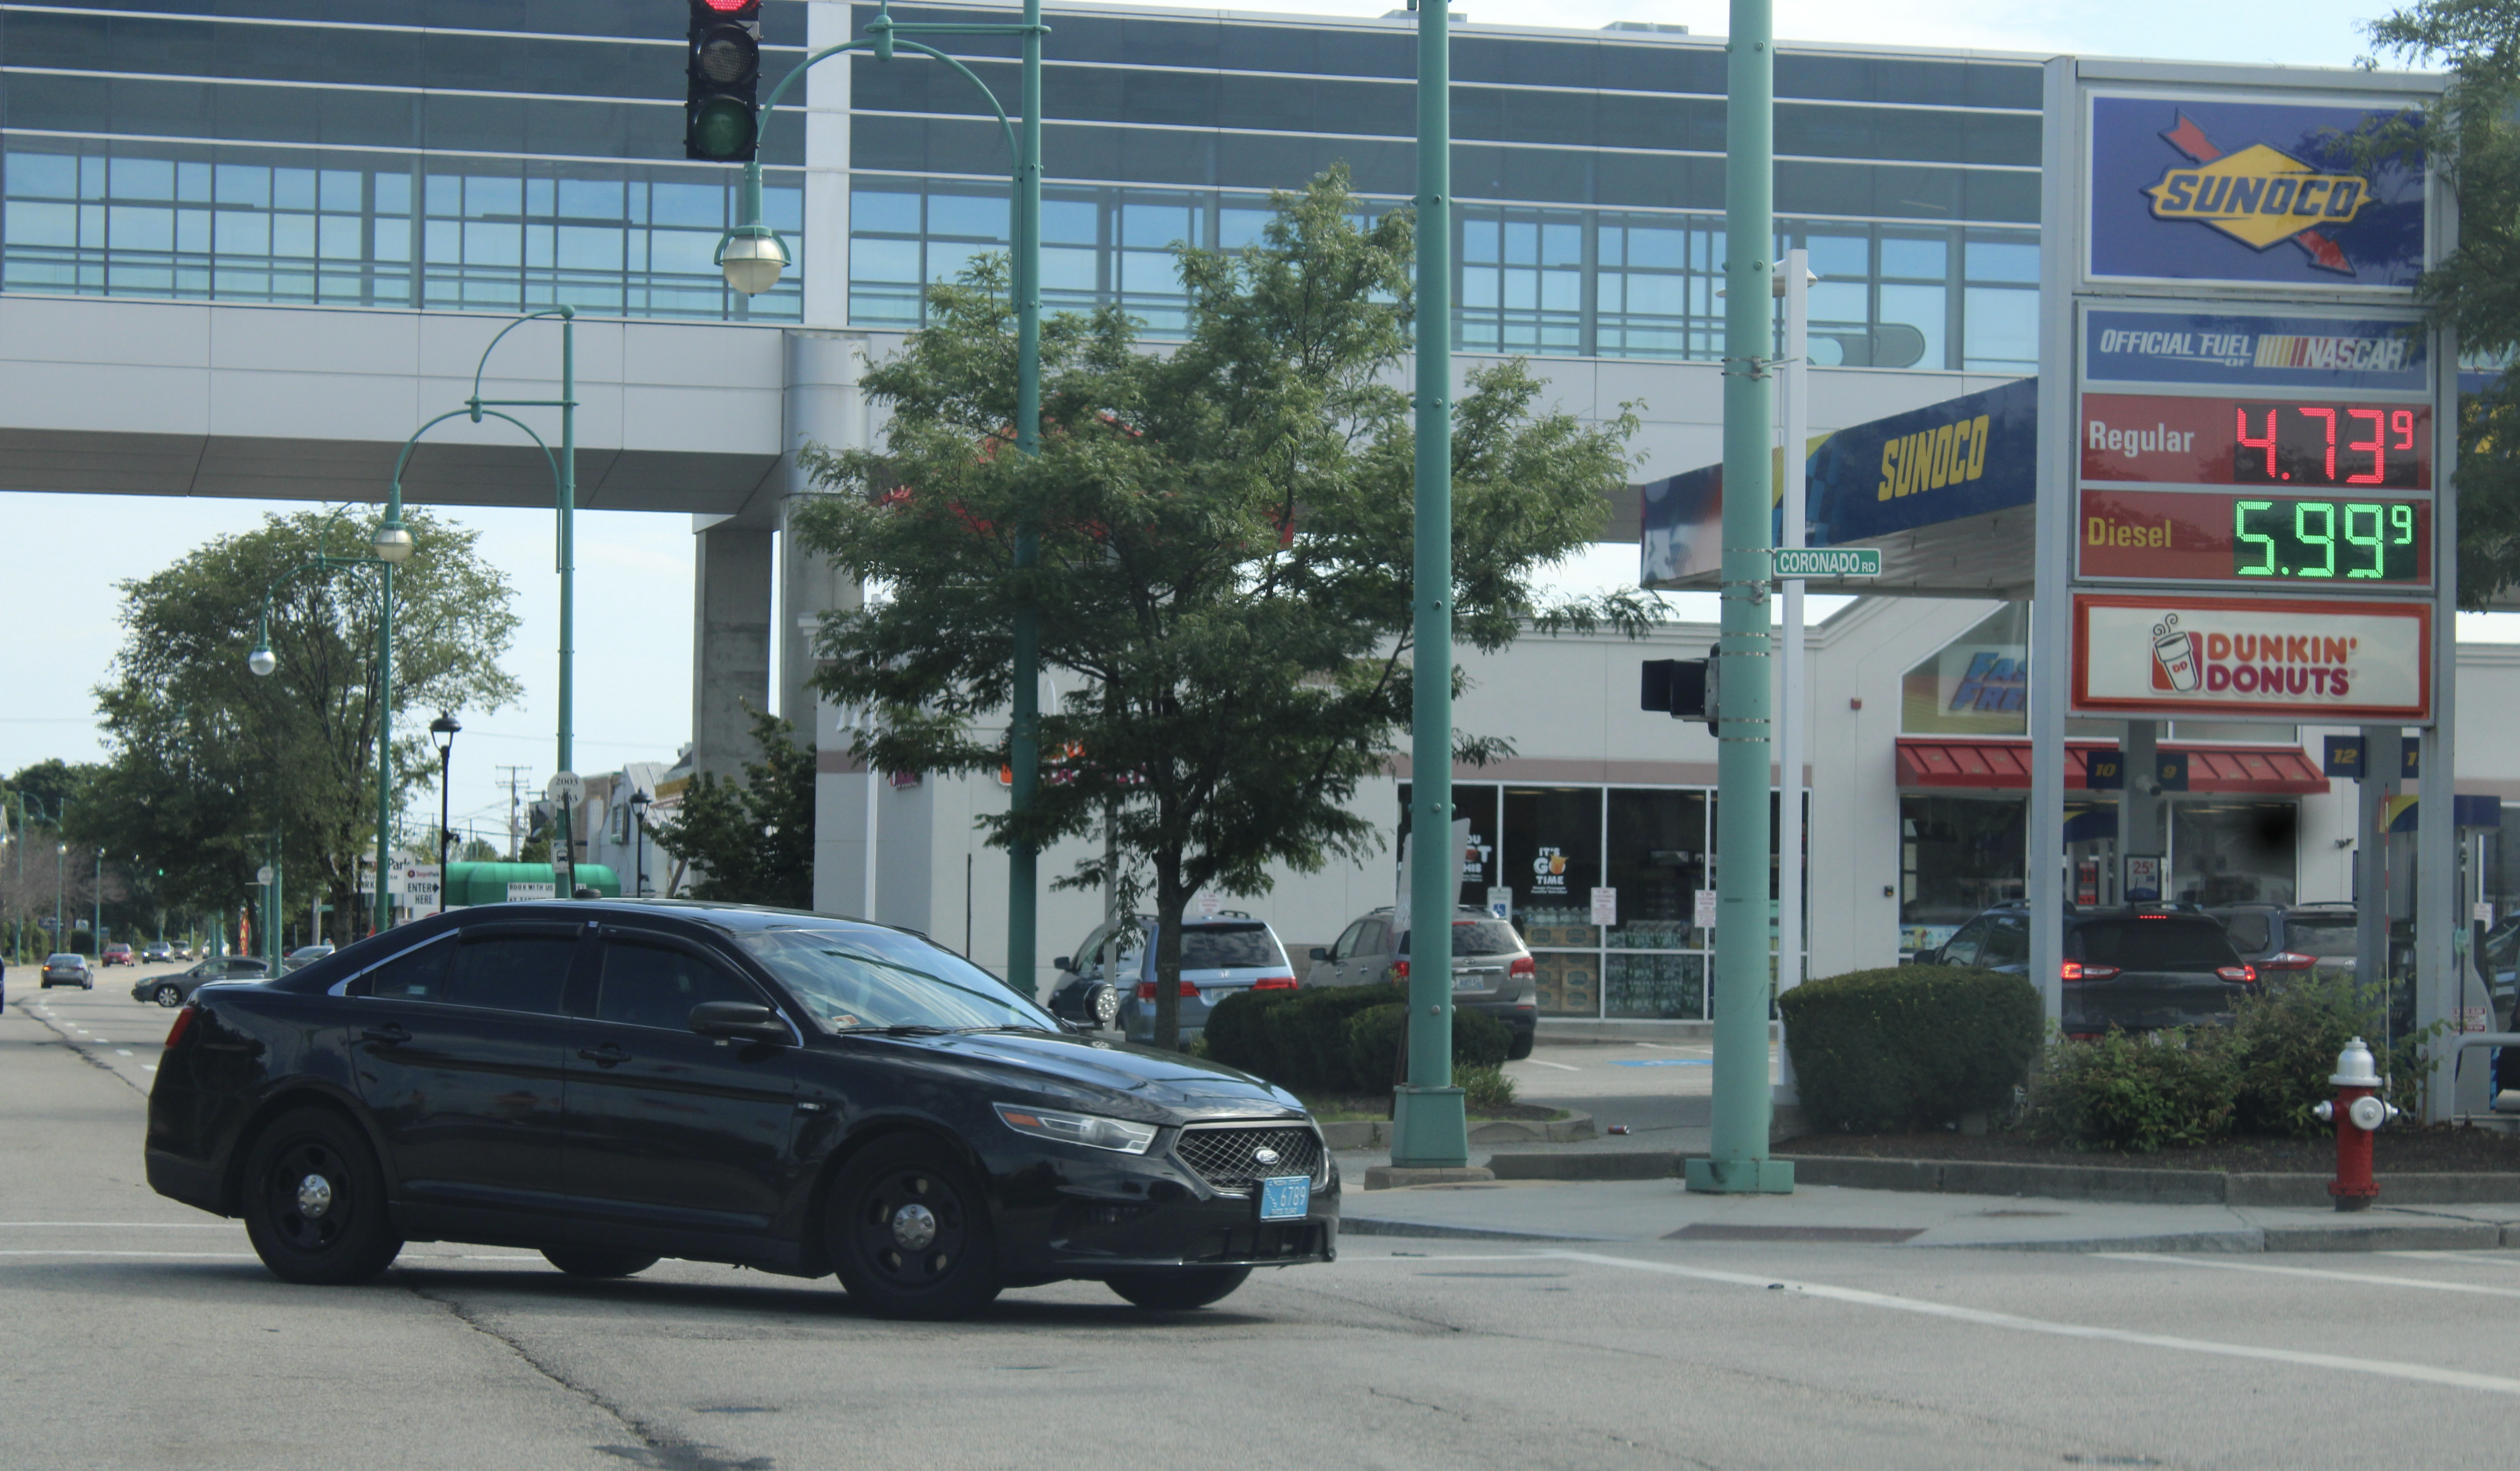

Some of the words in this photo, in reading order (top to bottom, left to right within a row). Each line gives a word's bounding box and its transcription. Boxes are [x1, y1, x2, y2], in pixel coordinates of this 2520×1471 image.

[2161, 174, 2362, 218] SUNOCO
[2100, 329, 2194, 355] OFFICIAL
[2198, 333, 2252, 357] FUEL
[2303, 336, 2404, 372] NASCAR
[2224, 357, 2250, 367] OF
[2088, 420, 2195, 458] Regular
[1878, 414, 1990, 502] SUNOCO
[2088, 517, 2172, 548] Diesel
[1780, 552, 1860, 572] CORONADO
[1861, 561, 1876, 572] RD
[2207, 632, 2357, 664] DUNKIN'
[2172, 661, 2188, 673] DD
[2207, 664, 2349, 696] DONUTS
[2333, 749, 2358, 764] 12
[2407, 751, 2419, 766] 1
[2095, 763, 2117, 777] 10
[2163, 765, 2177, 779] 9
[1539, 847, 1560, 857] IT'S
[1463, 863, 1482, 873] HIS
[408, 883, 432, 892] ENTER
[1536, 876, 1564, 885] TIME
[415, 894, 433, 905] HERE
[1281, 1186, 1306, 1207] 6789
